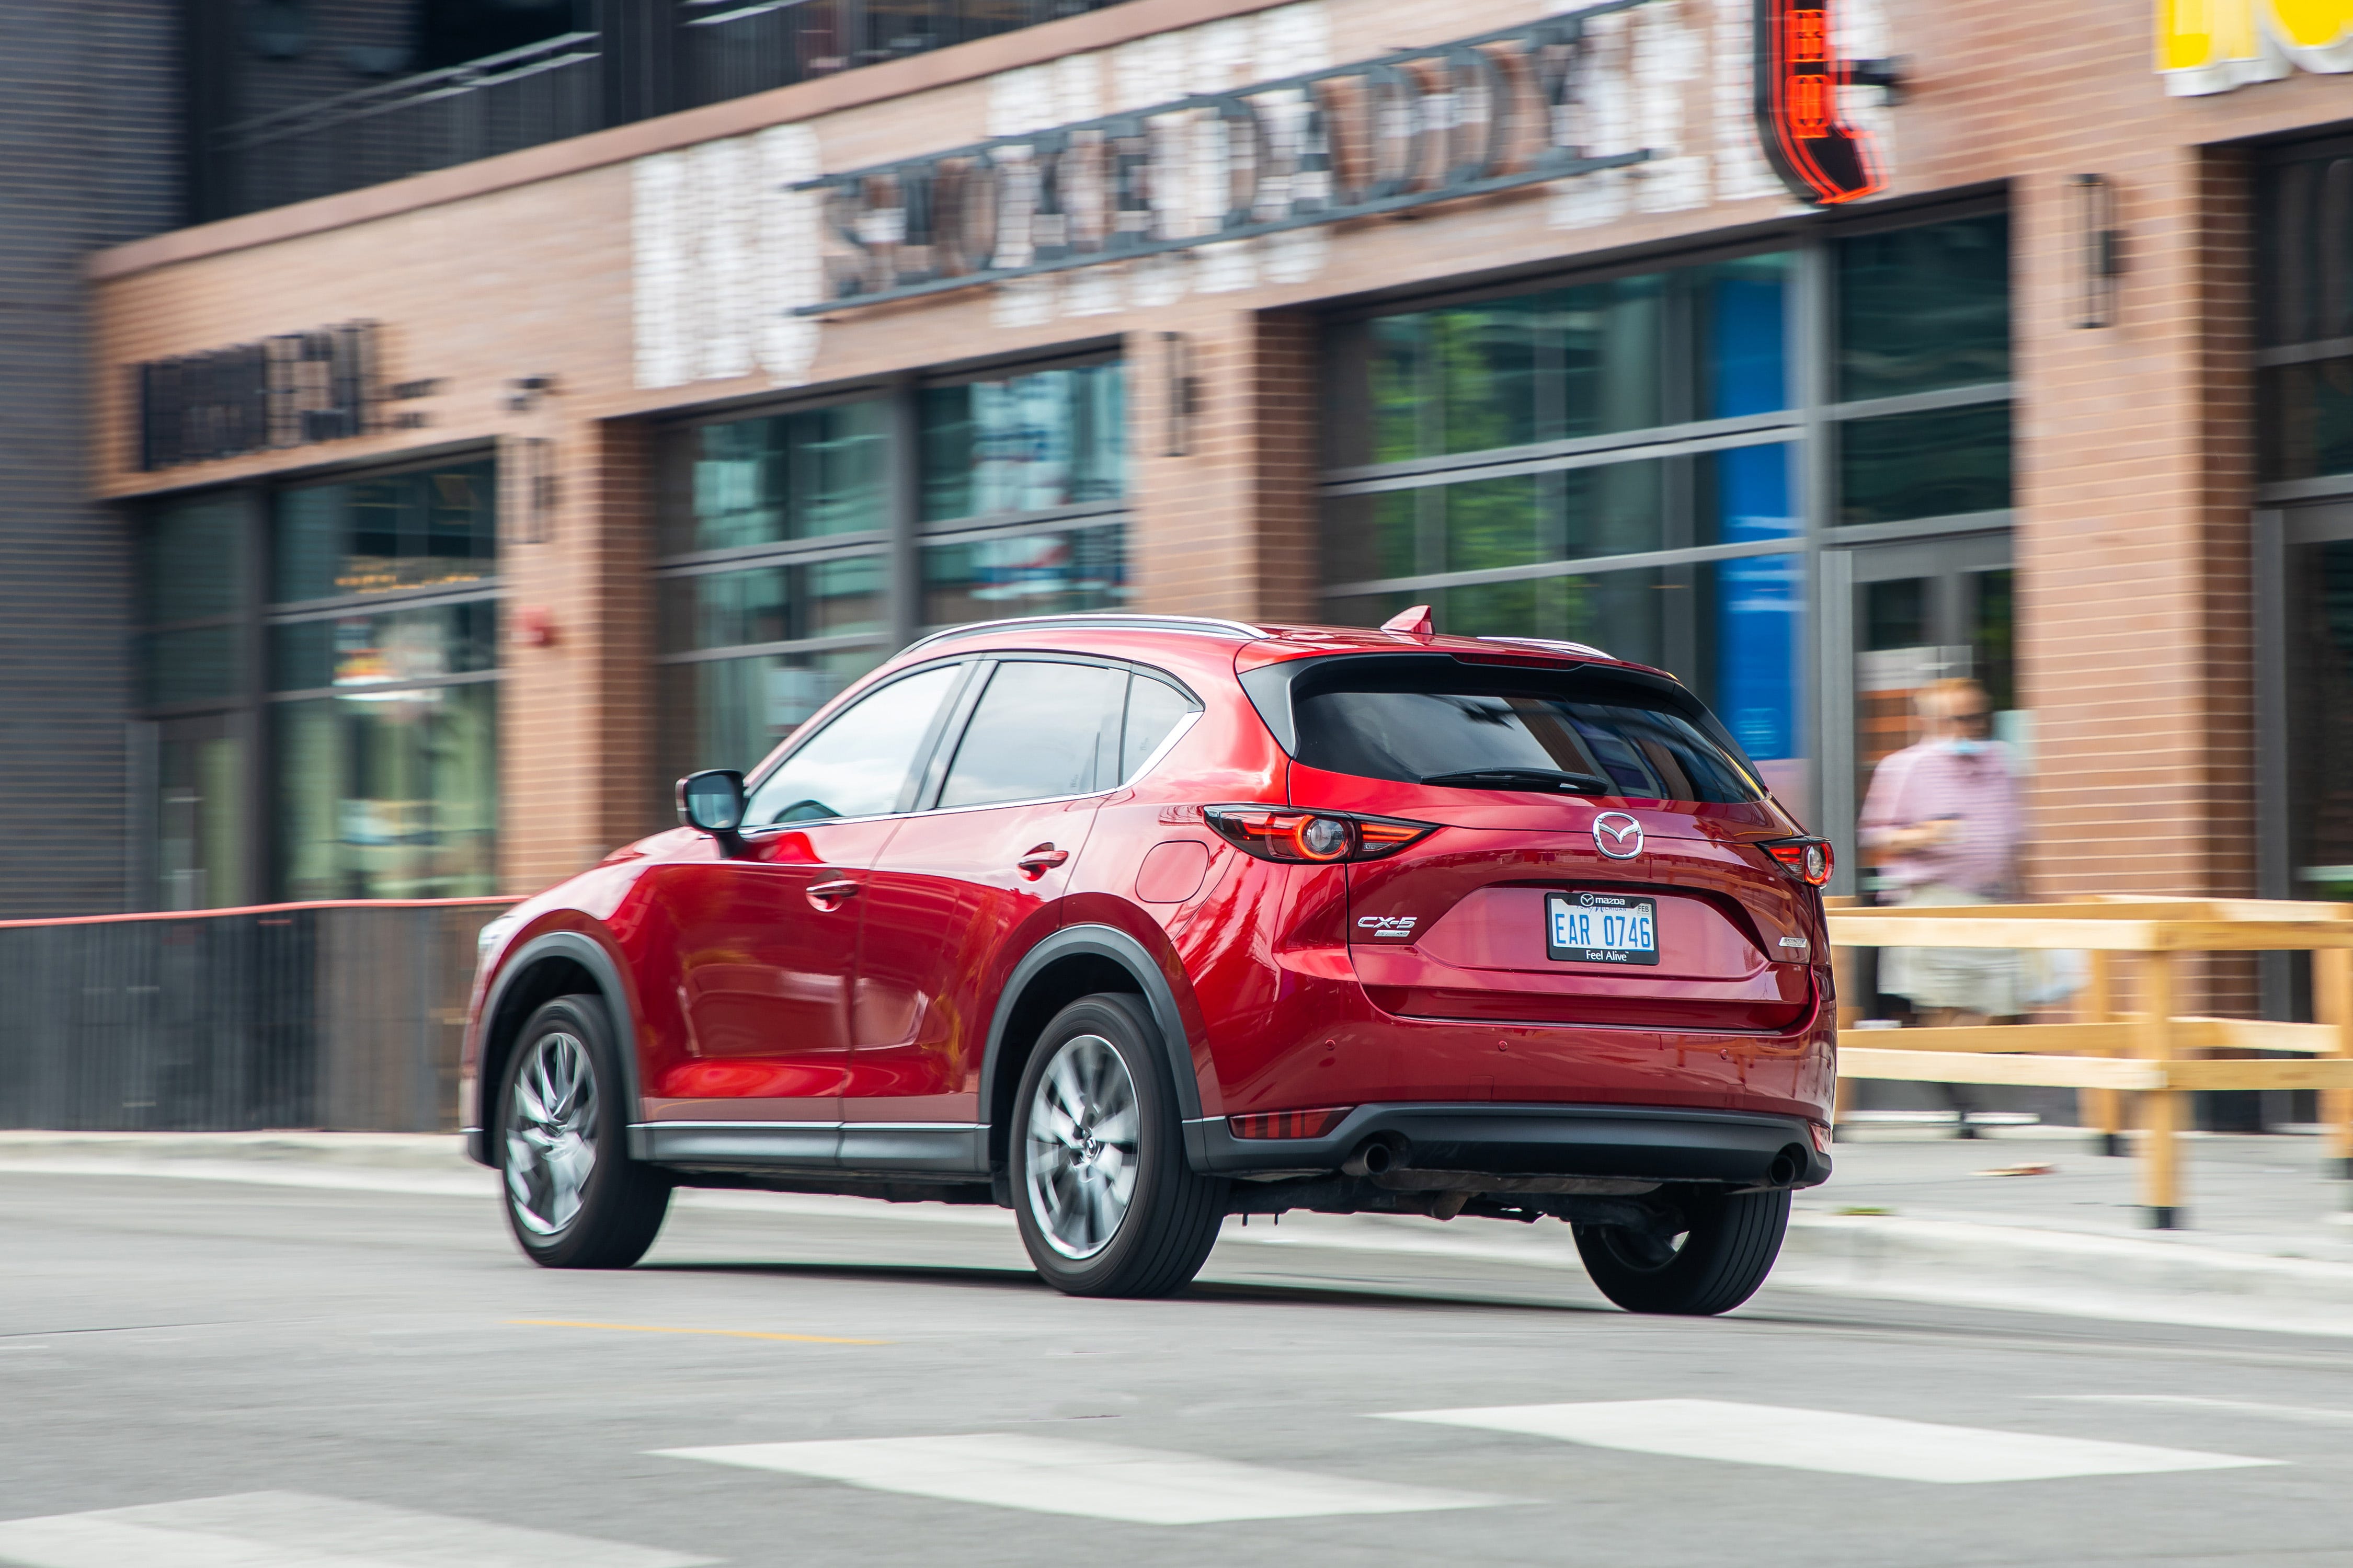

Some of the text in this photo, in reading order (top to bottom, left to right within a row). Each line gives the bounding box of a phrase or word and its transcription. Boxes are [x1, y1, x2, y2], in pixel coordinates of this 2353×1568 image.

[1357, 916, 1418, 929] CX-5
[1555, 913, 1651, 947] EAR 0746
[1586, 950, 1603, 960] Feel
